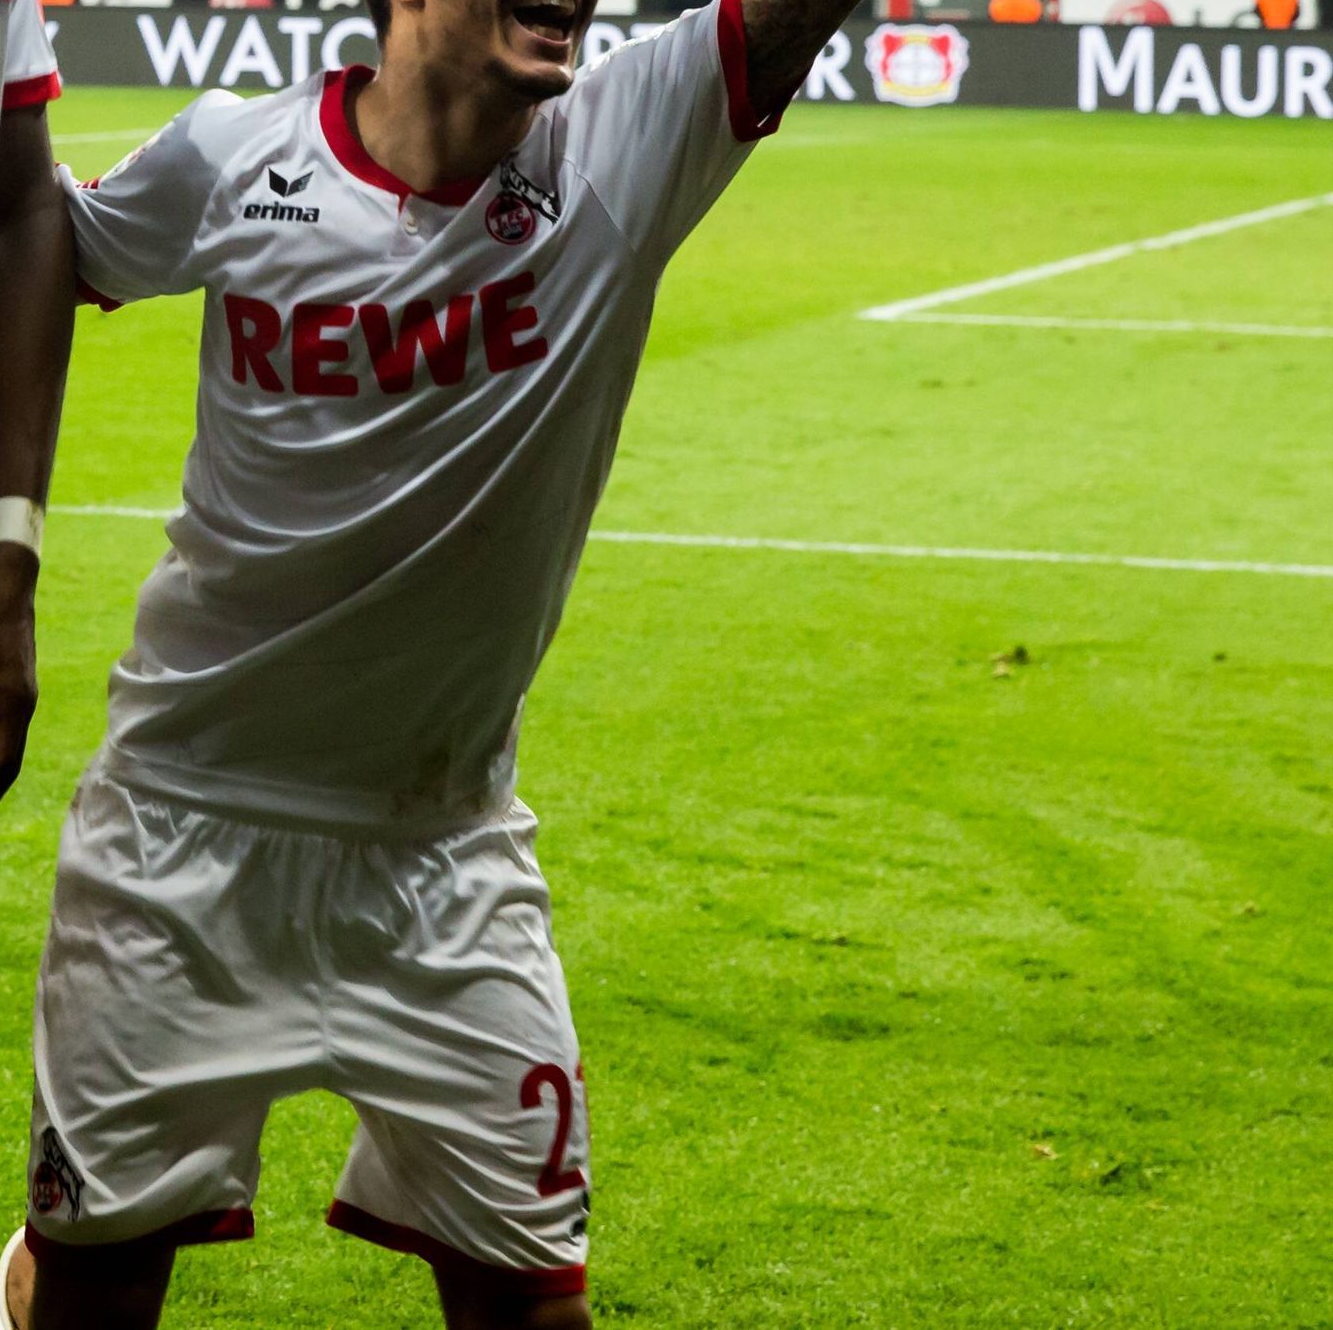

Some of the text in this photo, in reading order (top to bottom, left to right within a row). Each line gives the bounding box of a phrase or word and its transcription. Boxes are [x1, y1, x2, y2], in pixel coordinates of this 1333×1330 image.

[243, 201, 320, 224] erima
[224, 271, 548, 396] REWE
[520, 1062, 587, 1198] 2
